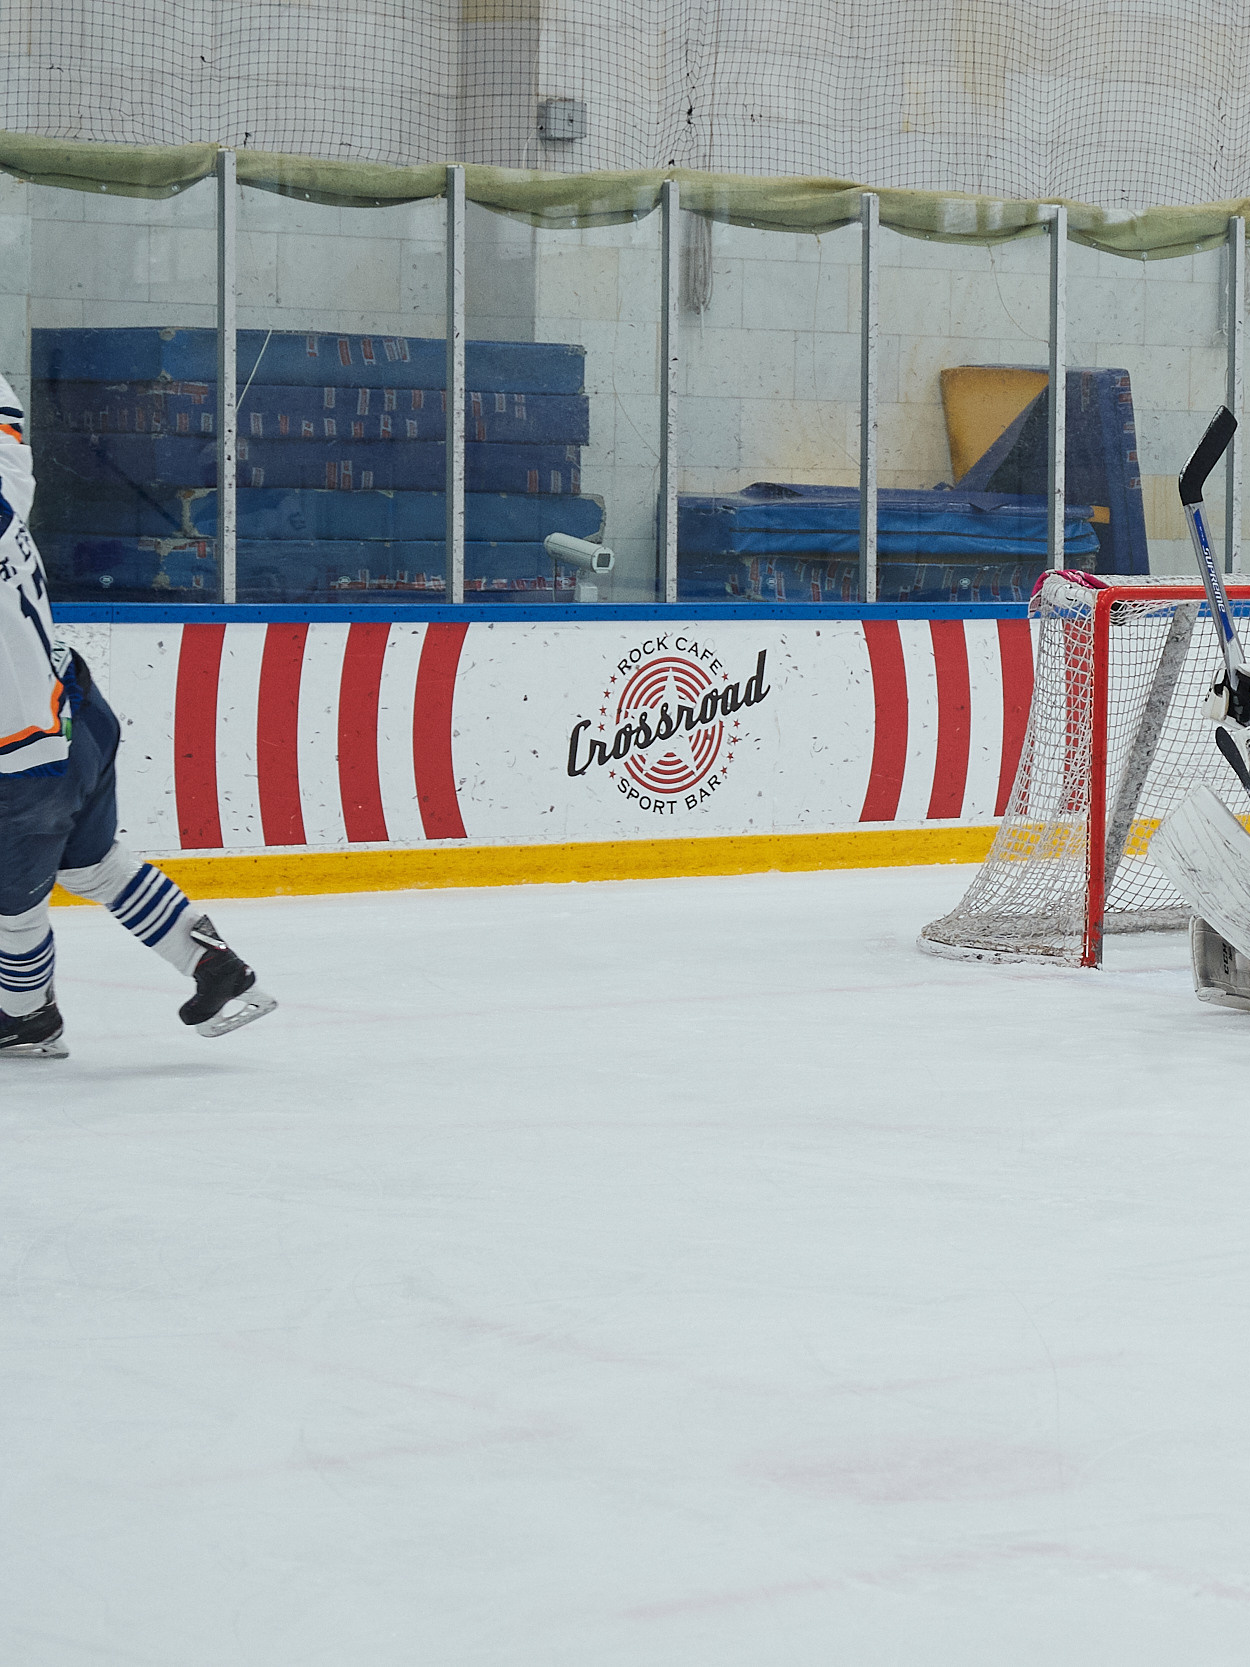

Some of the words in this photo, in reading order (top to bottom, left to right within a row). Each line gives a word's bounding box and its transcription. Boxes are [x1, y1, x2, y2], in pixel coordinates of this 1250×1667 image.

[617, 636, 668, 675] ROCK
[675, 637, 723, 676] CAFE
[567, 650, 771, 777] Crossroad
[617, 778, 677, 814] SPORT
[684, 774, 722, 811] BAR
